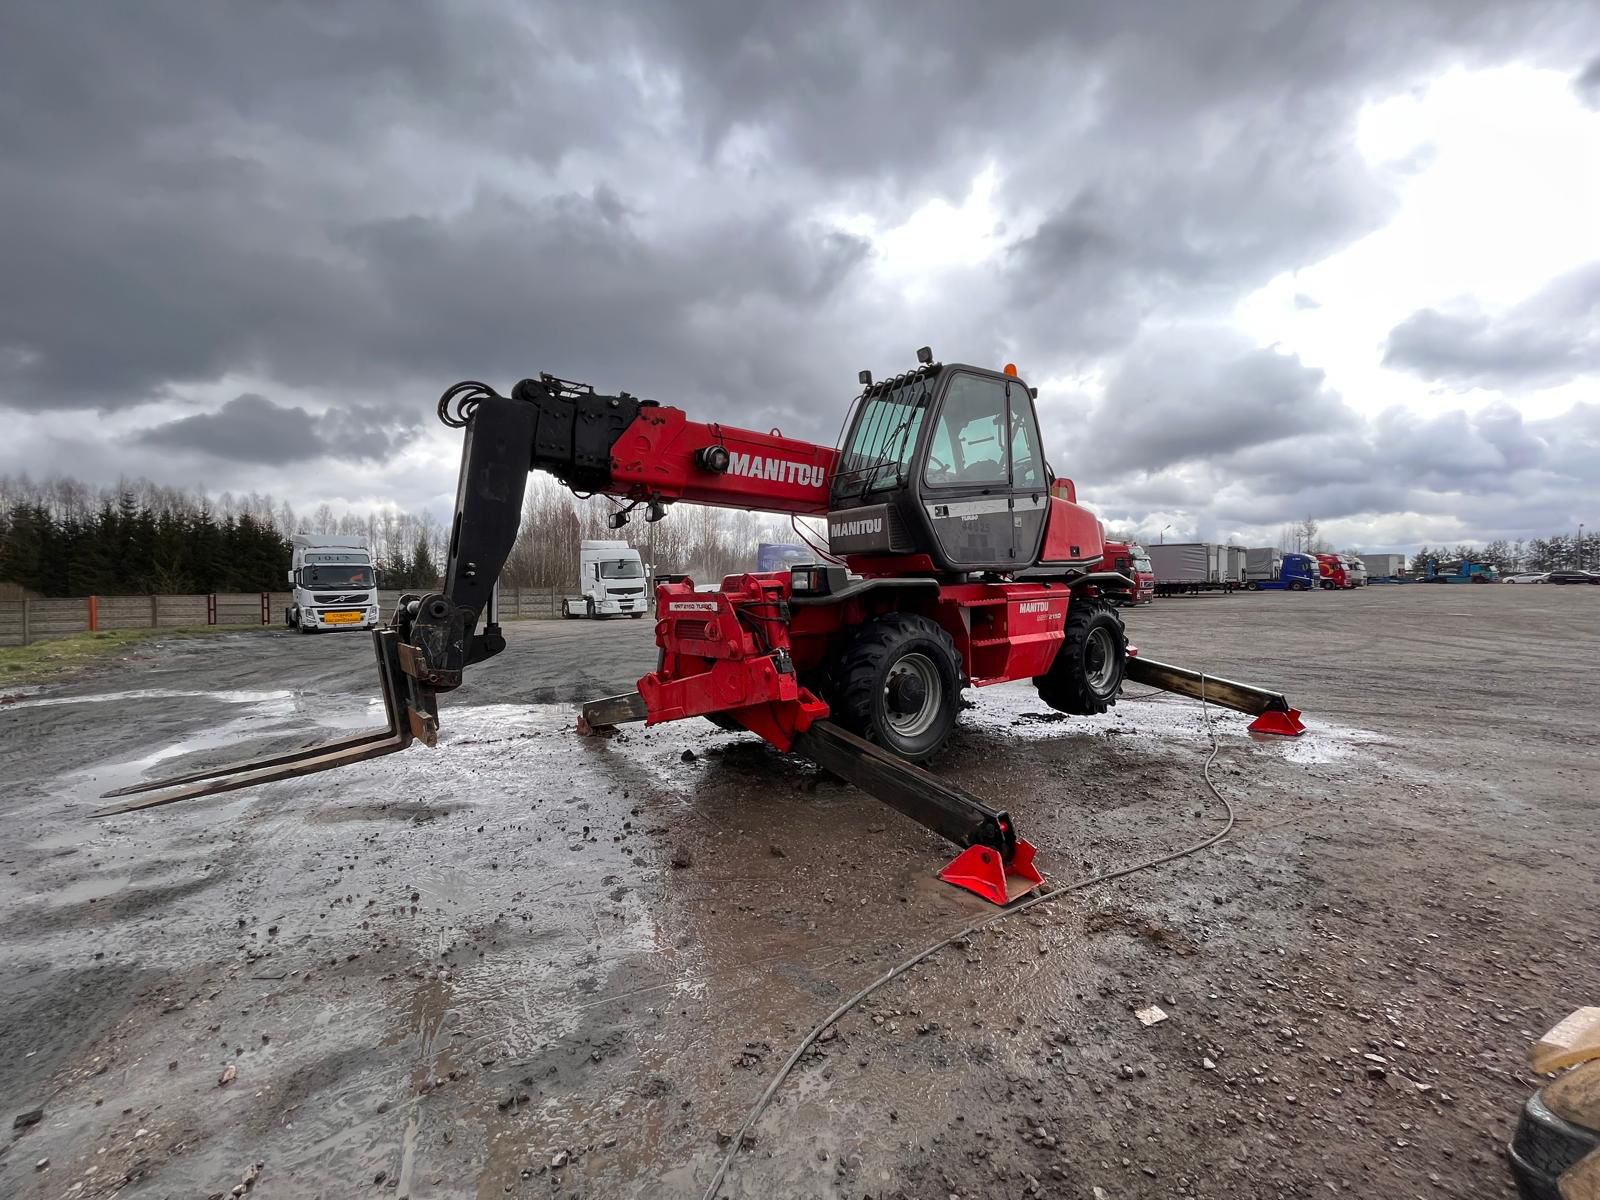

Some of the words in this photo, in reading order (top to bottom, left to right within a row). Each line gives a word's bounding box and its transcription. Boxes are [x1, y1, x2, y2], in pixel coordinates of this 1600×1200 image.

[726, 451, 825, 488] MANITOU
[831, 518, 882, 538] MANITOU
[1019, 601, 1049, 614] MANITOU
